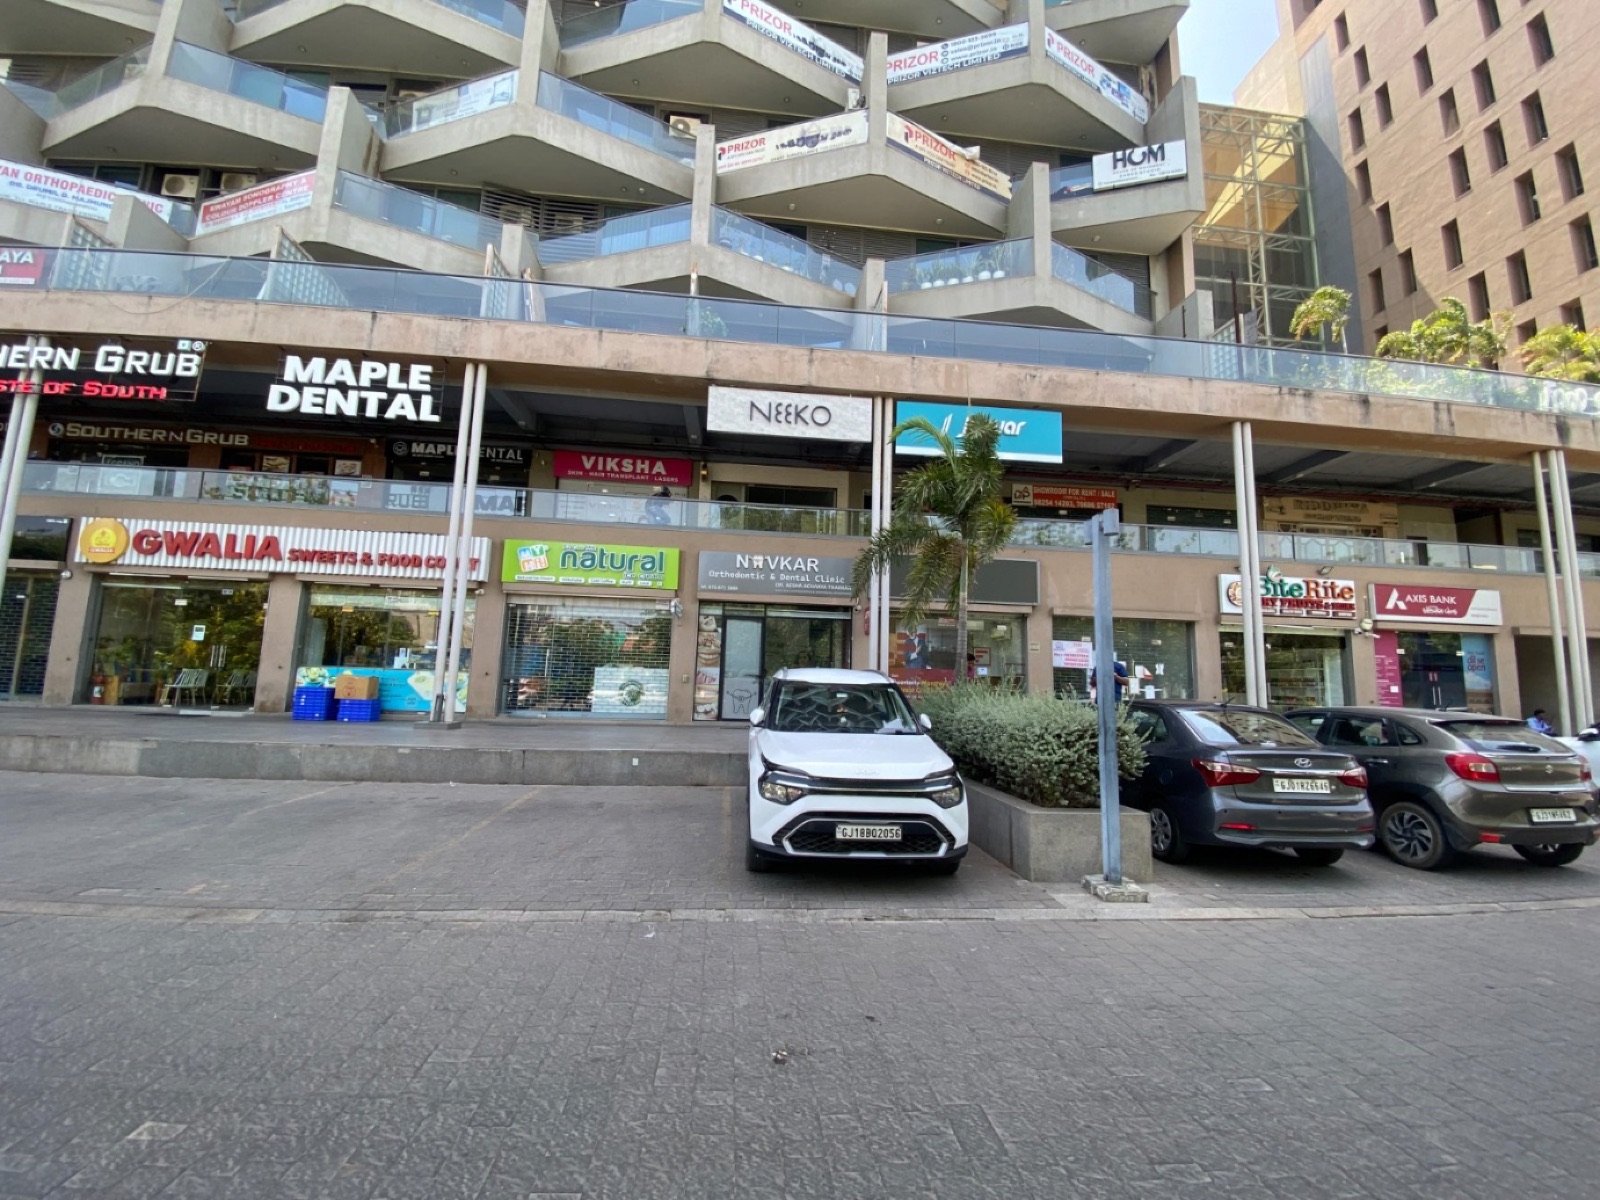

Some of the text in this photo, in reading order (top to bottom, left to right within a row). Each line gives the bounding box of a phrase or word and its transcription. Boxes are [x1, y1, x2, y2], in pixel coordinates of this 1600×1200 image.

[741, 0, 792, 35] PRIZOR
[1056, 42, 1095, 78] PRIZOR
[727, 137, 766, 154] PRIZOR
[915, 130, 956, 160] PRIZOR
[95, 345, 200, 377] GRUB
[284, 355, 433, 392] MAPLE
[43, 381, 76, 394] OF
[83, 381, 167, 399] SOUTH
[266, 384, 441, 422] DENTAL
[749, 401, 832, 427] NEEKO
[411, 442, 457, 456] MAPL
[581, 455, 666, 475] VIKSHA
[606, 473, 649, 481] TRANSPLANT
[1069, 488, 1079, 496] FOR
[1082, 489, 1096, 497] RENT
[132, 529, 283, 561] GWALIA
[288, 547, 357, 565] SWEETS
[360, 552, 373, 566] &
[378, 552, 422, 568] FOOD
[560, 547, 664, 573] natural
[709, 569, 764, 580] Orthodontic
[780, 573, 810, 582] Dental
[815, 575, 845, 584] Clinic
[1405, 594, 1457, 605] AXIS BANK
